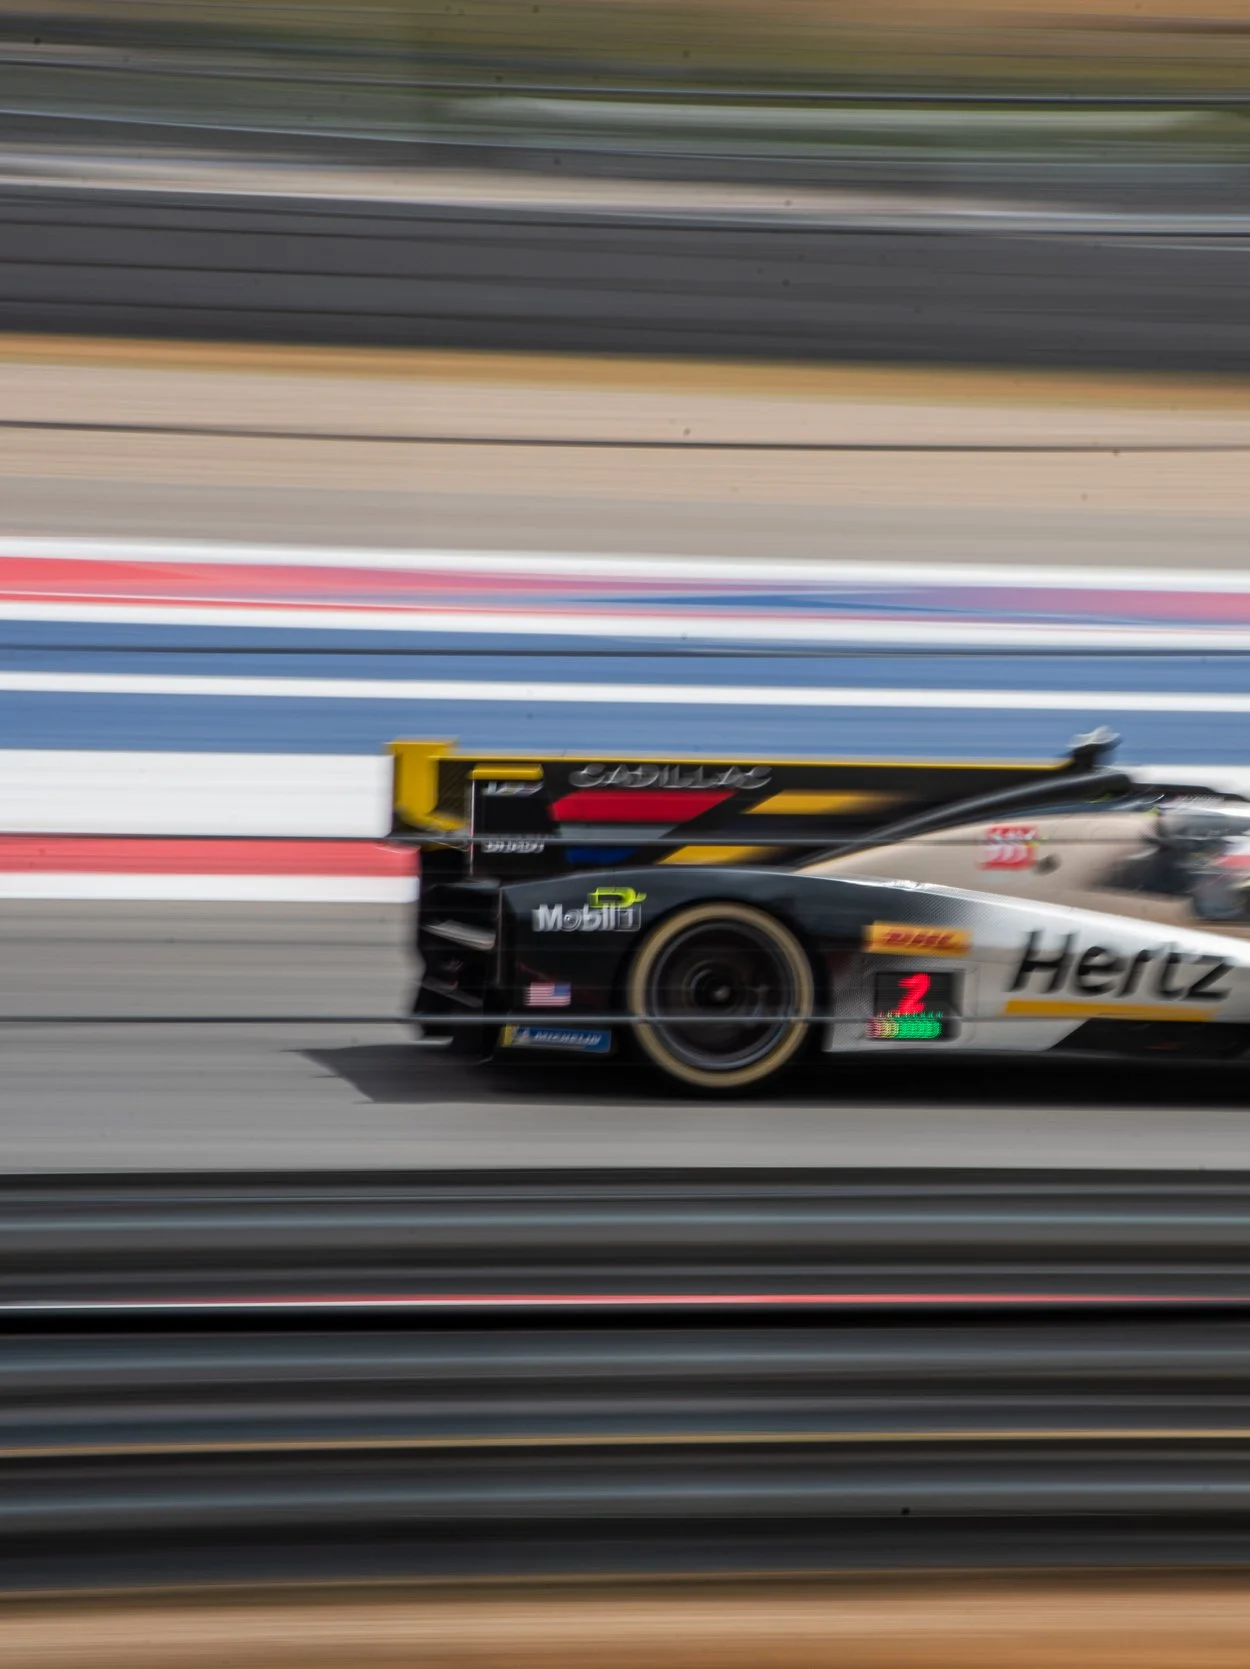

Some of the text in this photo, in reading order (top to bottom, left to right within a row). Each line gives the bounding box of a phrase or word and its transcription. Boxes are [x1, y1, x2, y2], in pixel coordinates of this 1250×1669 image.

[568, 764, 773, 789] CADILLAC
[532, 903, 616, 932] Mobil
[1004, 928, 1235, 1002] Hertz
[897, 972, 931, 1015] 2
